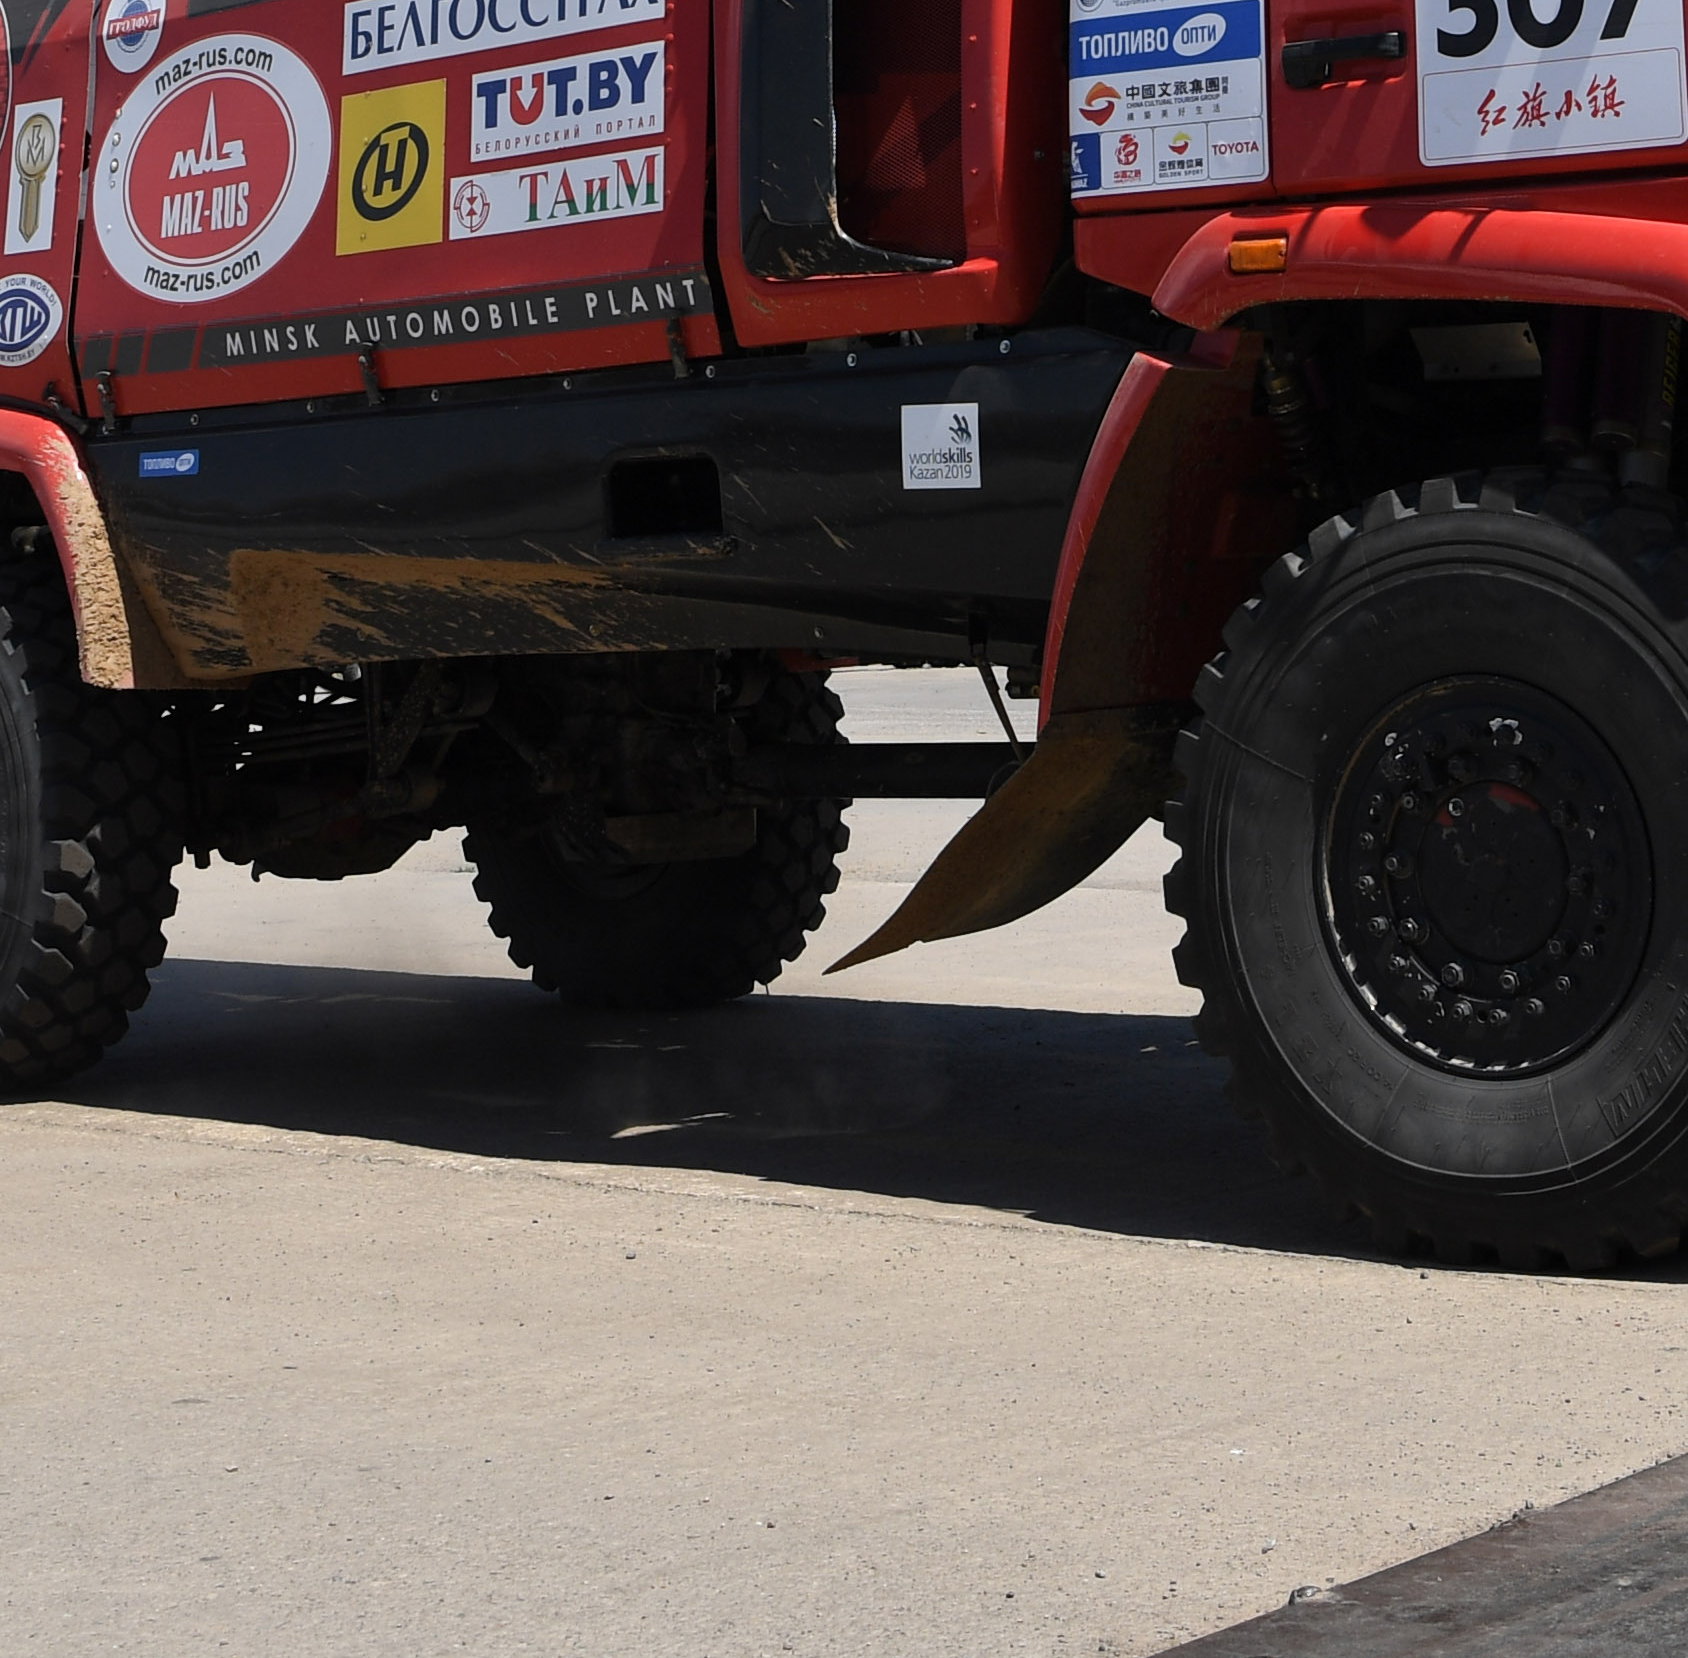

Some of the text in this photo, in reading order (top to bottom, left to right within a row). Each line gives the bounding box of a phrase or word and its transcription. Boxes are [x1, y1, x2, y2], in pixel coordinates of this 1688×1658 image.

[1079, 24, 1217, 60] ТОПЛИВО ОПТИ
[155, 46, 273, 95] maz-rus.com
[477, 51, 658, 129] TUT.BY
[1476, 73, 1626, 137] 红旗小镇
[475, 114, 656, 154] БЕЛОРУССКИЙ ПОРТАЛ
[1212, 141, 1259, 155] TOYOTA
[161, 182, 249, 238] MAZ-RUS
[5, 277, 27, 288] YOUR
[144, 250, 261, 292] maz-rus.com
[225, 278, 697, 357] MINSK AUTOMOBILE PLANT
[909, 447, 973, 464] worldskills
[909, 464, 972, 480] Kazan 2019
